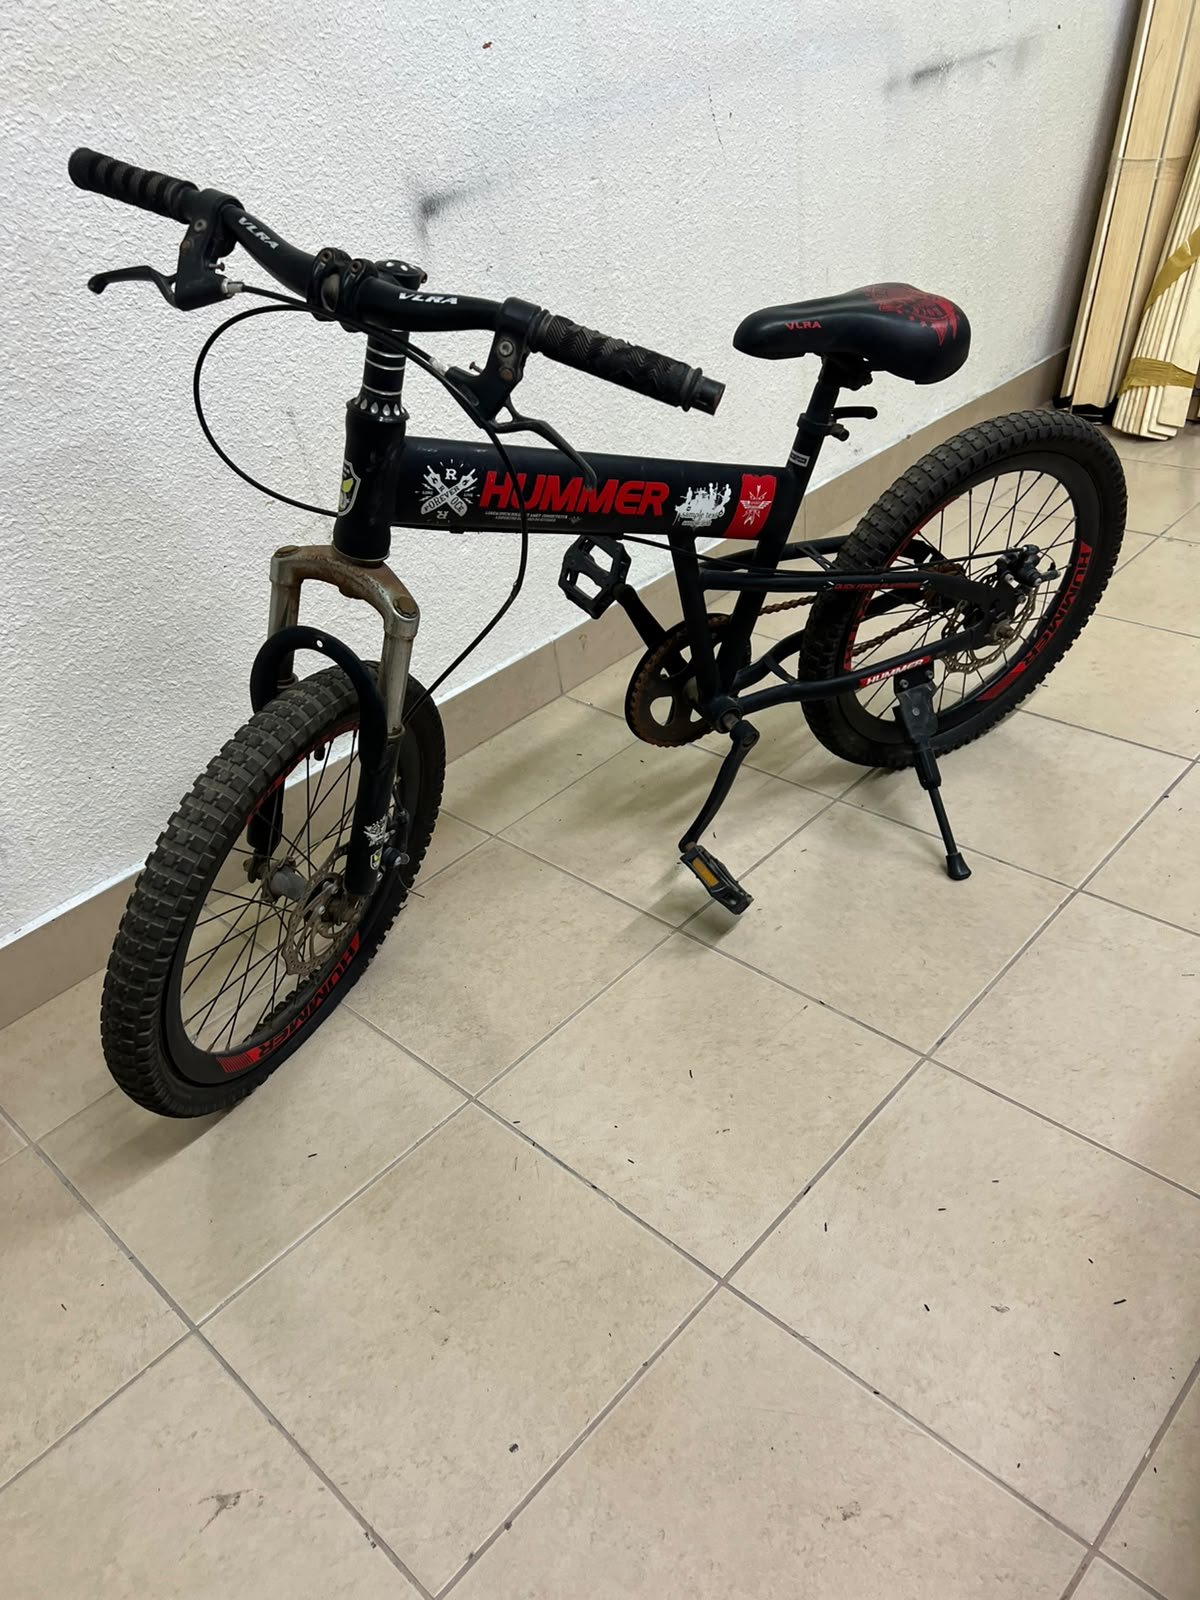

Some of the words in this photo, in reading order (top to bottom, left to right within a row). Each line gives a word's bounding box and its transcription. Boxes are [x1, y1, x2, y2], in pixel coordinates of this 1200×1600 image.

[238, 216, 279, 250] VLRA
[399, 292, 458, 305] VLRA
[784, 320, 822, 330] VLRA
[444, 468, 457, 480] R
[423, 485, 461, 512] FOREVER
[479, 470, 670, 517] HUMMER
[866, 659, 924, 685] HUMMER
